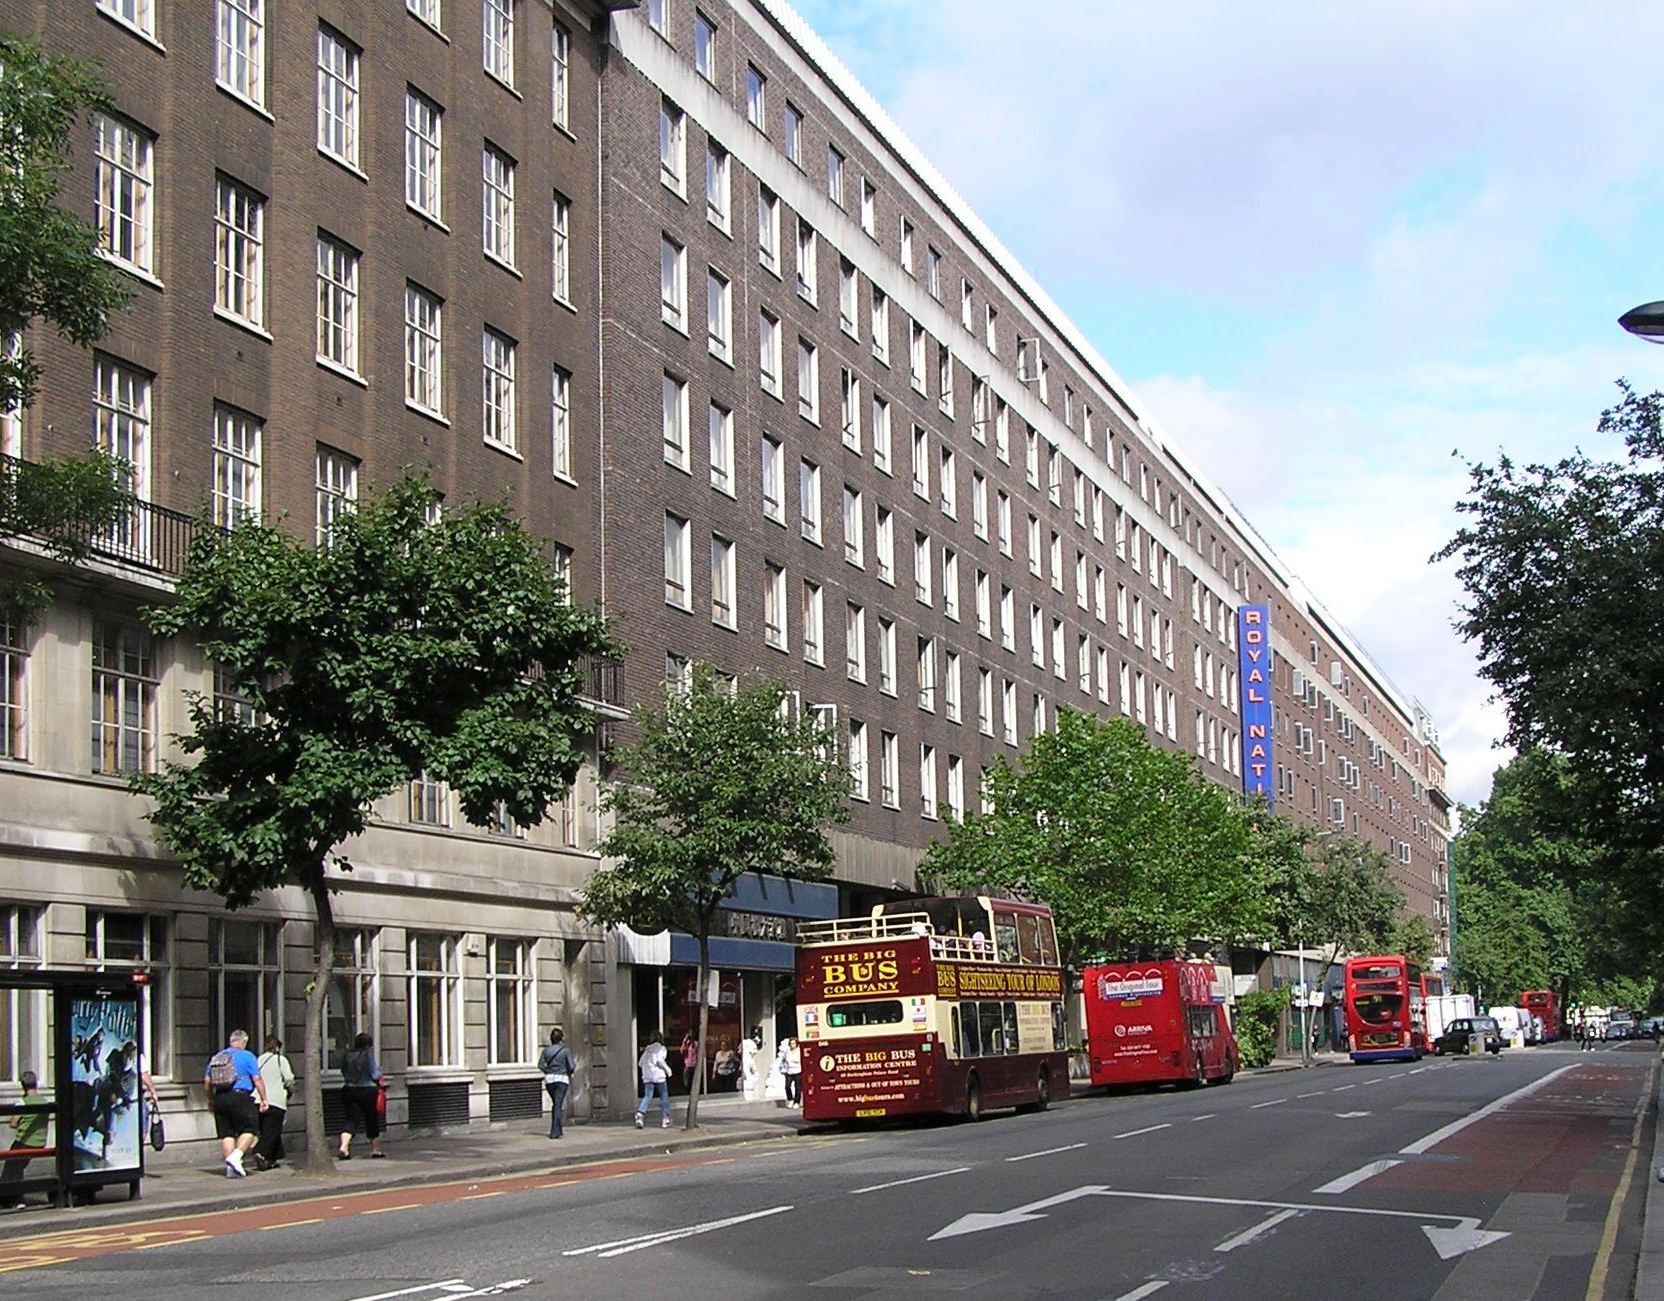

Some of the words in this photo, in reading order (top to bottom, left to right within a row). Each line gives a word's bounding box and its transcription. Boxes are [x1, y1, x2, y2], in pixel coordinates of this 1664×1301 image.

[1245, 611, 1264, 702] ROYAL
[821, 953, 859, 963] THE
[863, 950, 896, 960] BIG
[822, 960, 898, 984] BUS
[937, 971, 956, 987] BUS
[823, 981, 898, 995] COMPANY
[959, 972, 1006, 990] SIGHTSEEING
[1006, 974, 1025, 990] TOUR
[1026, 975, 1035, 991] OF
[1036, 975, 1060, 992] LONDON
[835, 1054, 861, 1064] THE
[865, 1051, 887, 1061] BIG
[891, 1049, 916, 1060] BUS
[836, 1063, 882, 1072] INFORMATION
[884, 1060, 917, 1068] CENTRE
